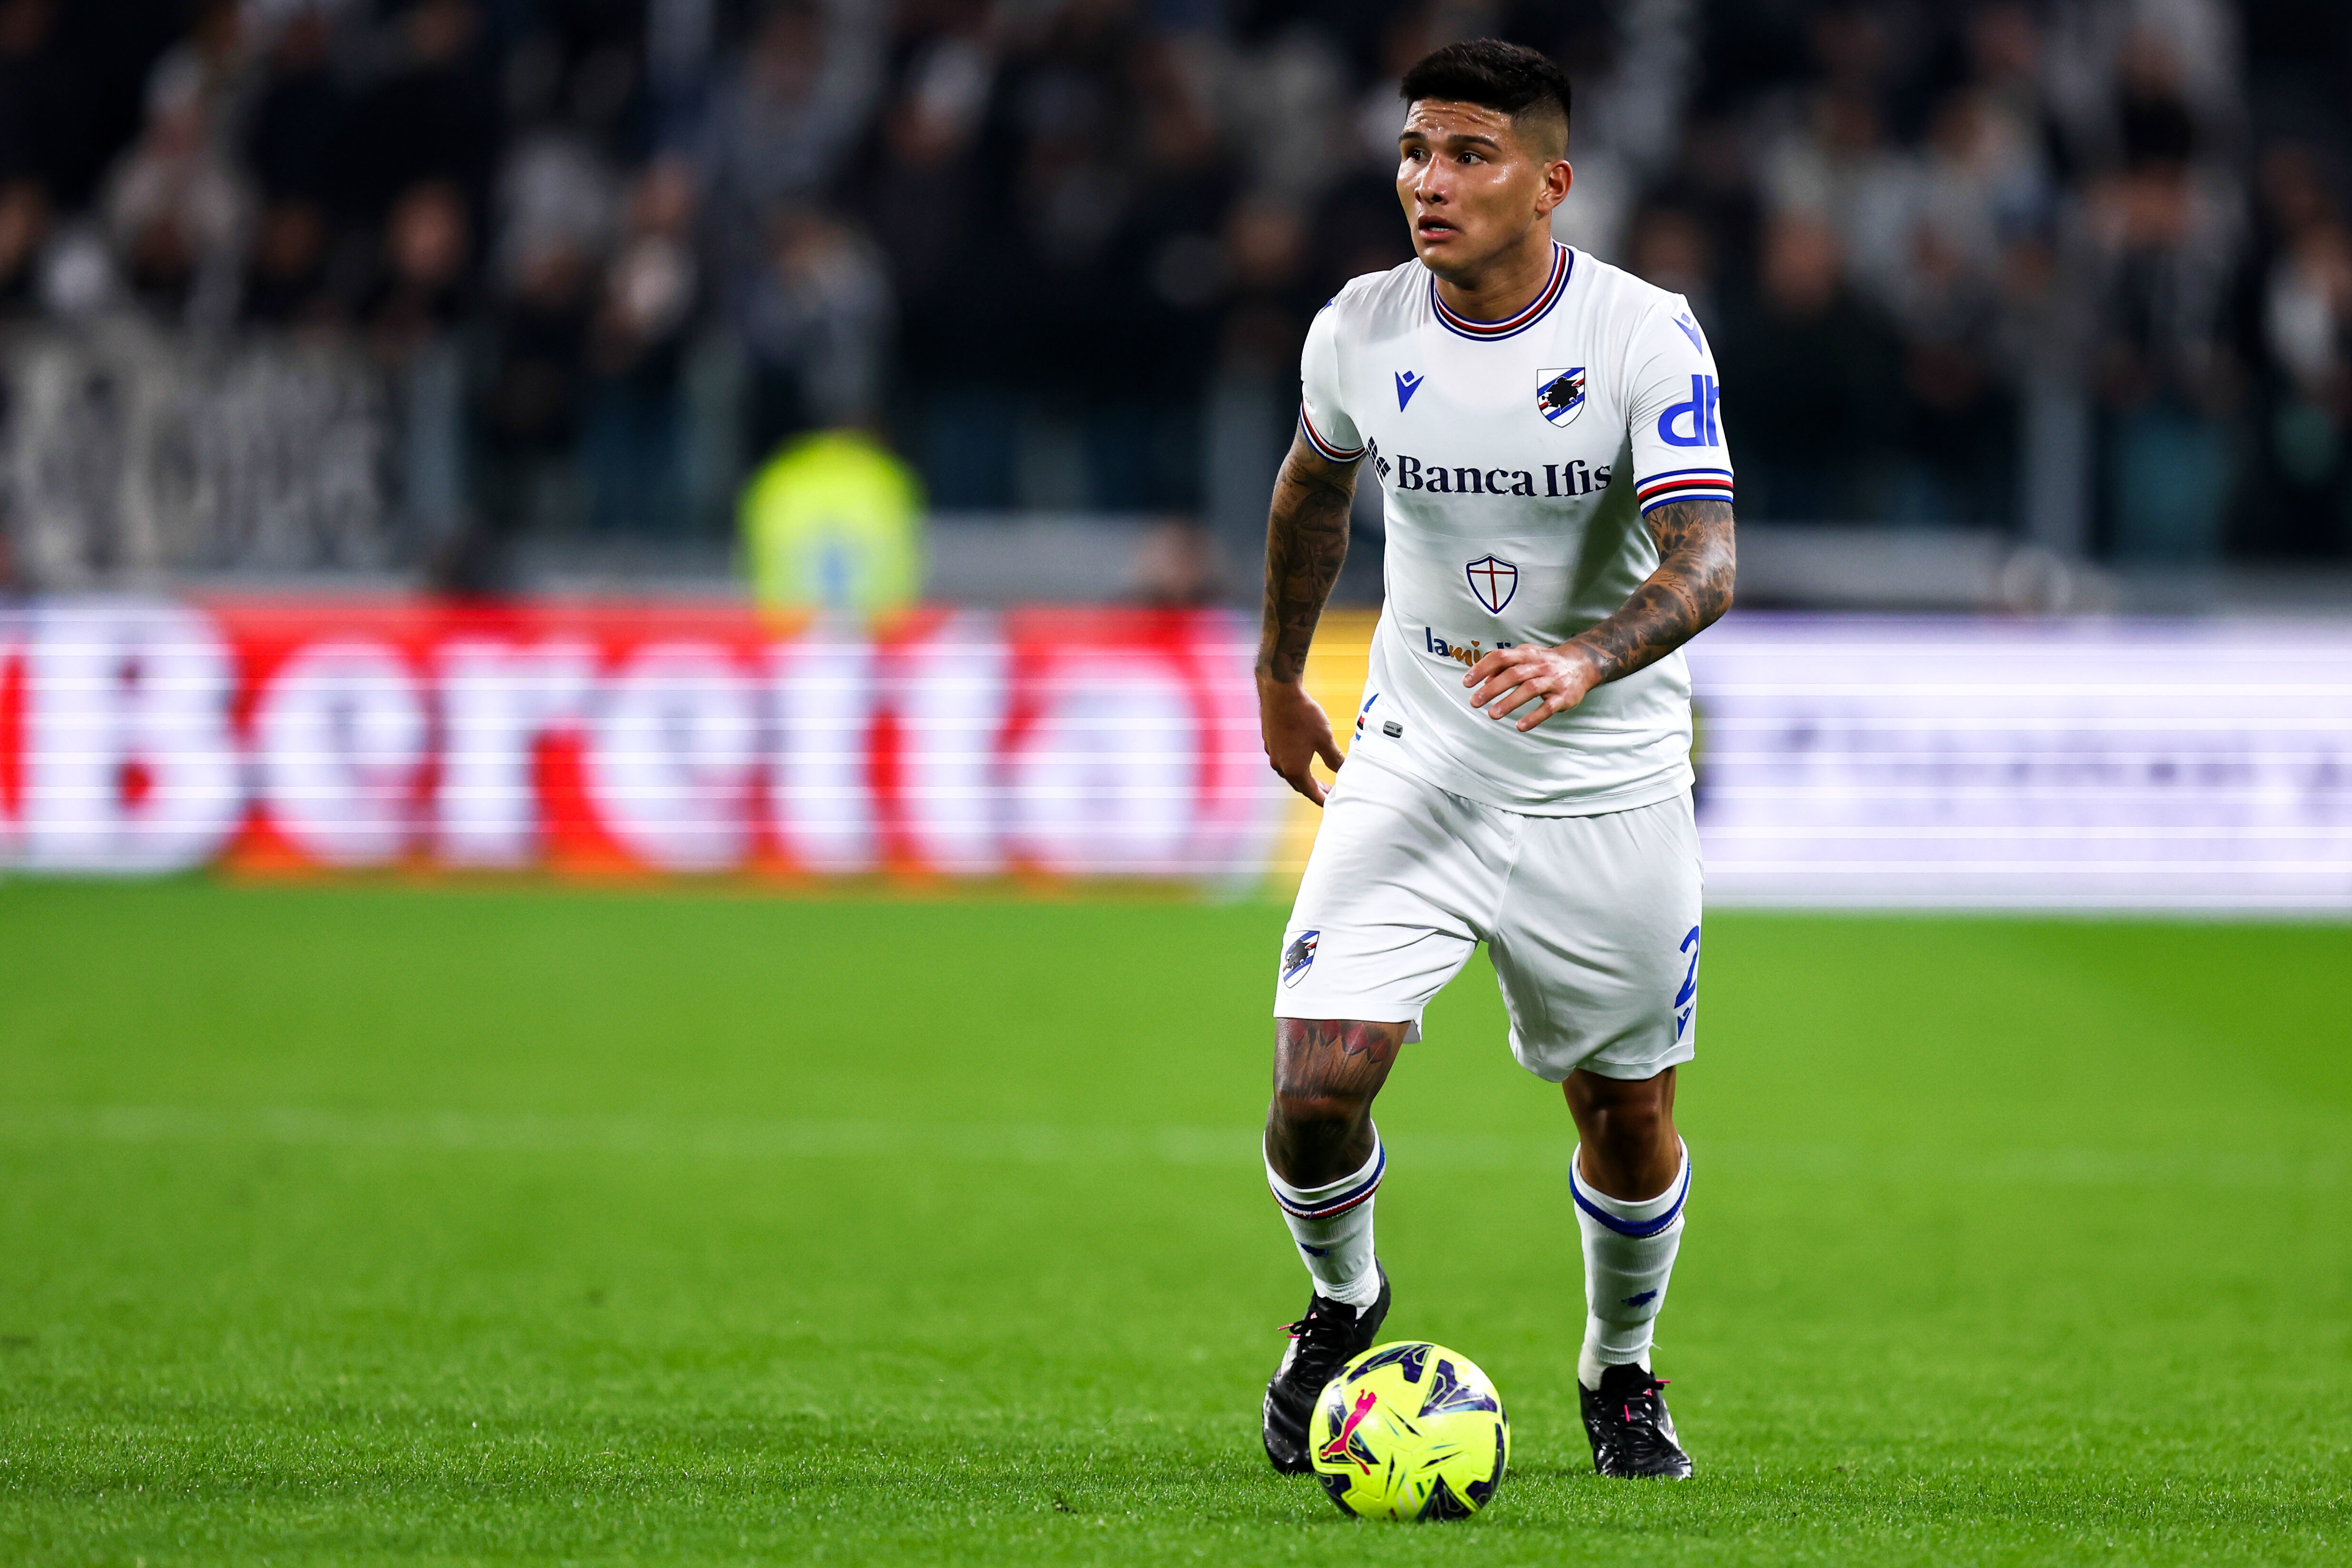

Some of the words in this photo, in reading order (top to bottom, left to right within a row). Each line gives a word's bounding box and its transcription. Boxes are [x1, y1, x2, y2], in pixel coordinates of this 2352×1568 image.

[1397, 455, 1537, 496] Banca
[1543, 460, 1612, 497] Ifis
[1674, 925, 1699, 1010] 2
